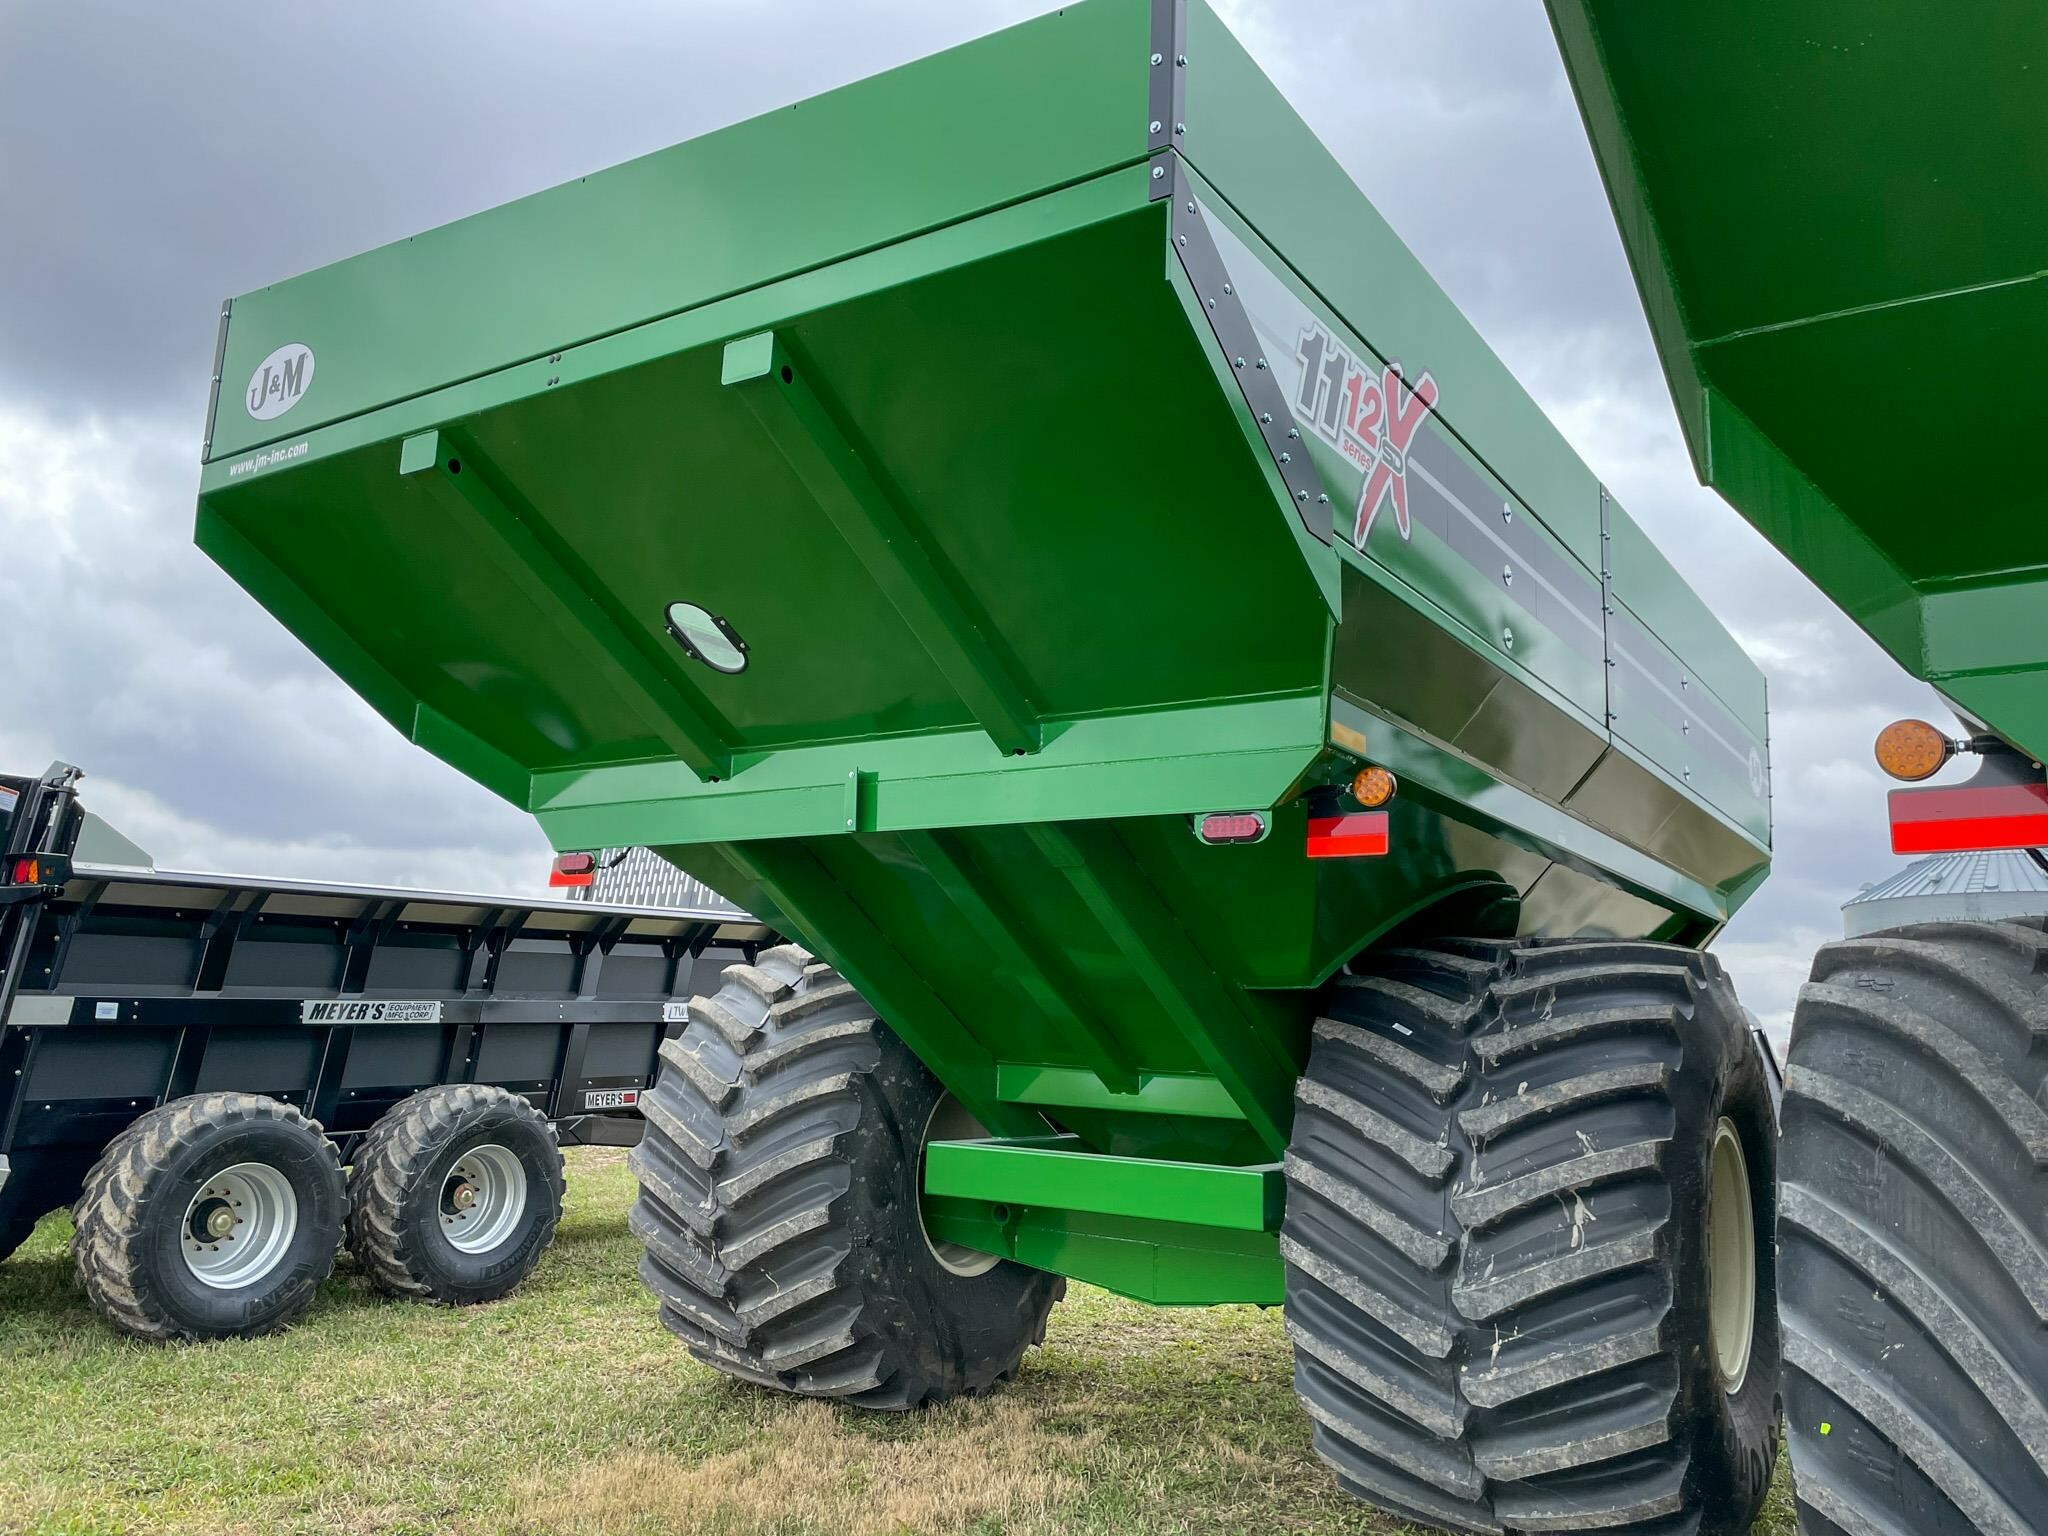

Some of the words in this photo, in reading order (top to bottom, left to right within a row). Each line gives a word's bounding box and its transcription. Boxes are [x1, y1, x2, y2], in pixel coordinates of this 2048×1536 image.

[250, 352, 308, 412] J&M
[1298, 328, 1383, 450] 1112
[229, 441, 308, 476] www.jm-inc.com
[1344, 437, 1372, 472] series
[309, 1003, 385, 1020] MEYER'S
[674, 1006, 688, 1017] TW
[588, 1093, 623, 1107] MEYER'S
